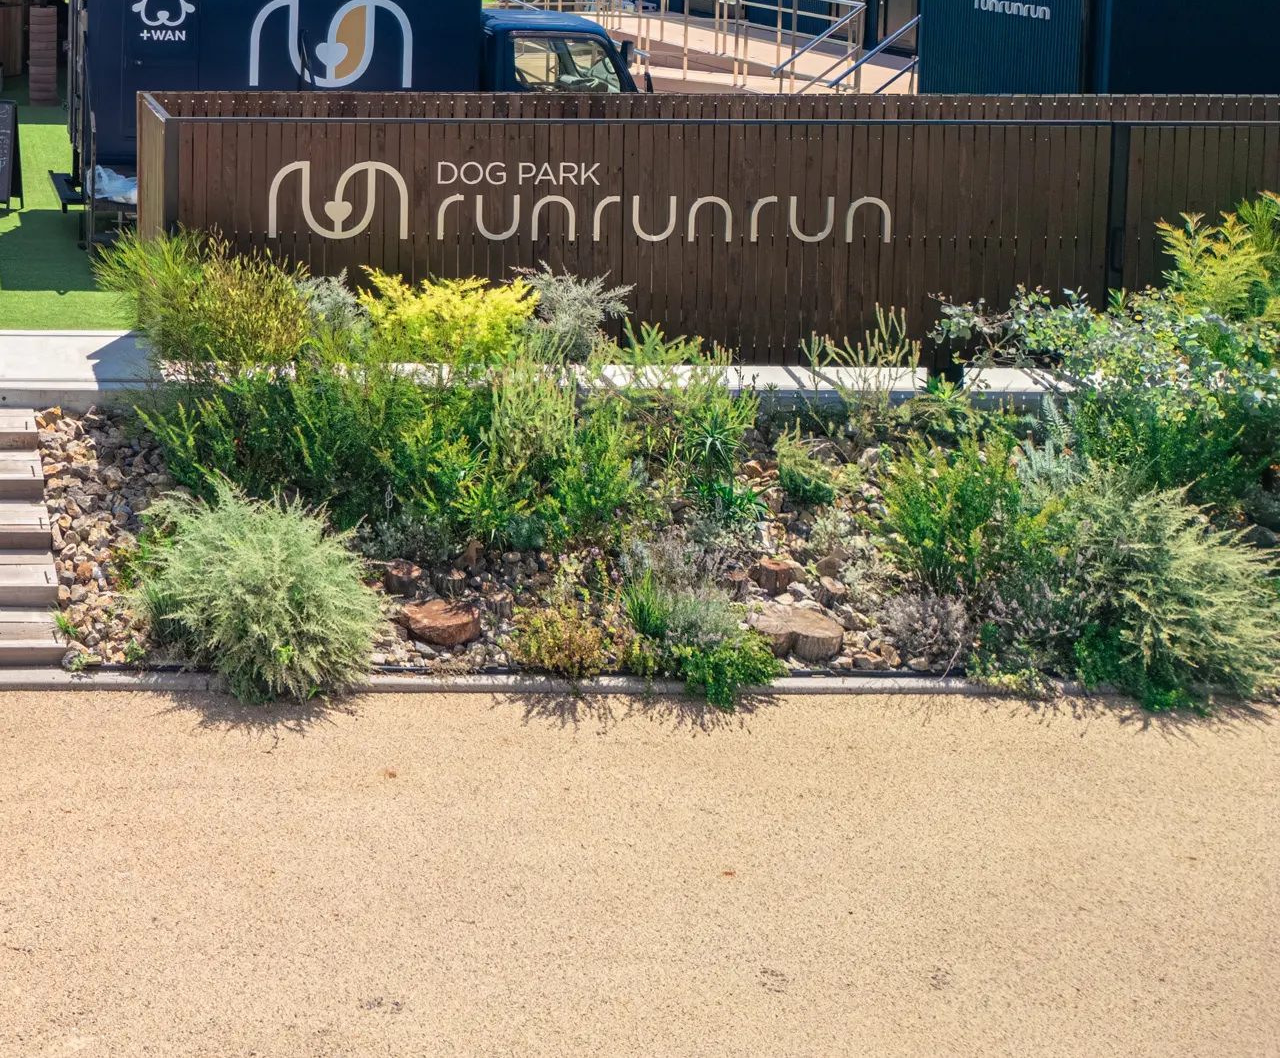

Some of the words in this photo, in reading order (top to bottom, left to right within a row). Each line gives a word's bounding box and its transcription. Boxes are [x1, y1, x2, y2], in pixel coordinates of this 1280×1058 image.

[437, 161, 507, 185] DOG
[518, 162, 601, 186] PARK
[436, 194, 892, 243] runrunrun
